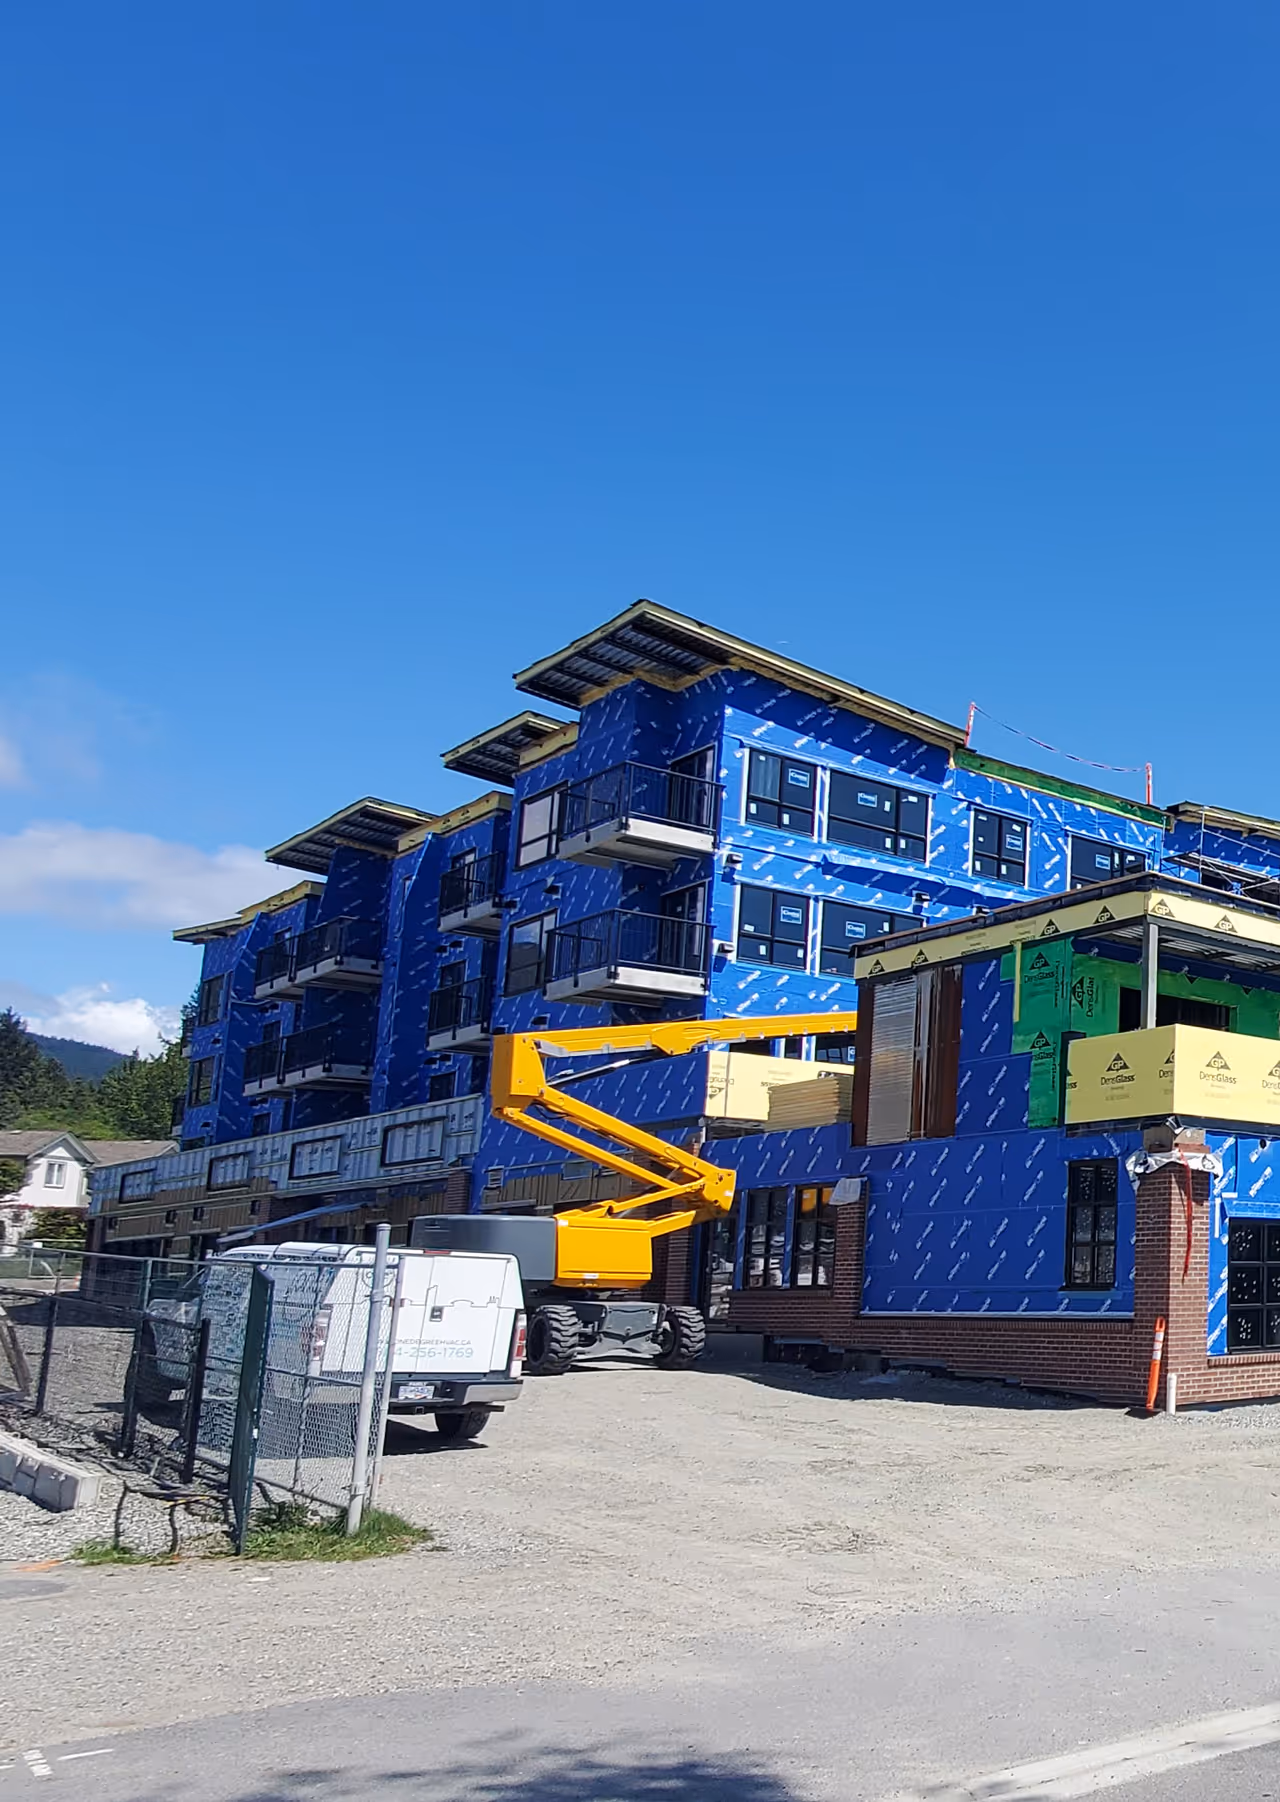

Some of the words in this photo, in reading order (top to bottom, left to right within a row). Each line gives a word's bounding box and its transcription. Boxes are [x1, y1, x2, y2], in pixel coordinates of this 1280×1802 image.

[1155, 904, 1170, 916] GP
[1098, 911, 1111, 923] GP
[1043, 924, 1057, 935] GP
[1218, 920, 1232, 931] GP
[1033, 958, 1046, 969] GP
[1034, 1038, 1046, 1047] GP
[1111, 1059, 1124, 1071] GP
[1211, 1059, 1226, 1070] GP
[1101, 1074, 1136, 1086] DensGlass
[1200, 1071, 1238, 1085] DensGlass
[393, 1347, 474, 1359] 4-256-1769
